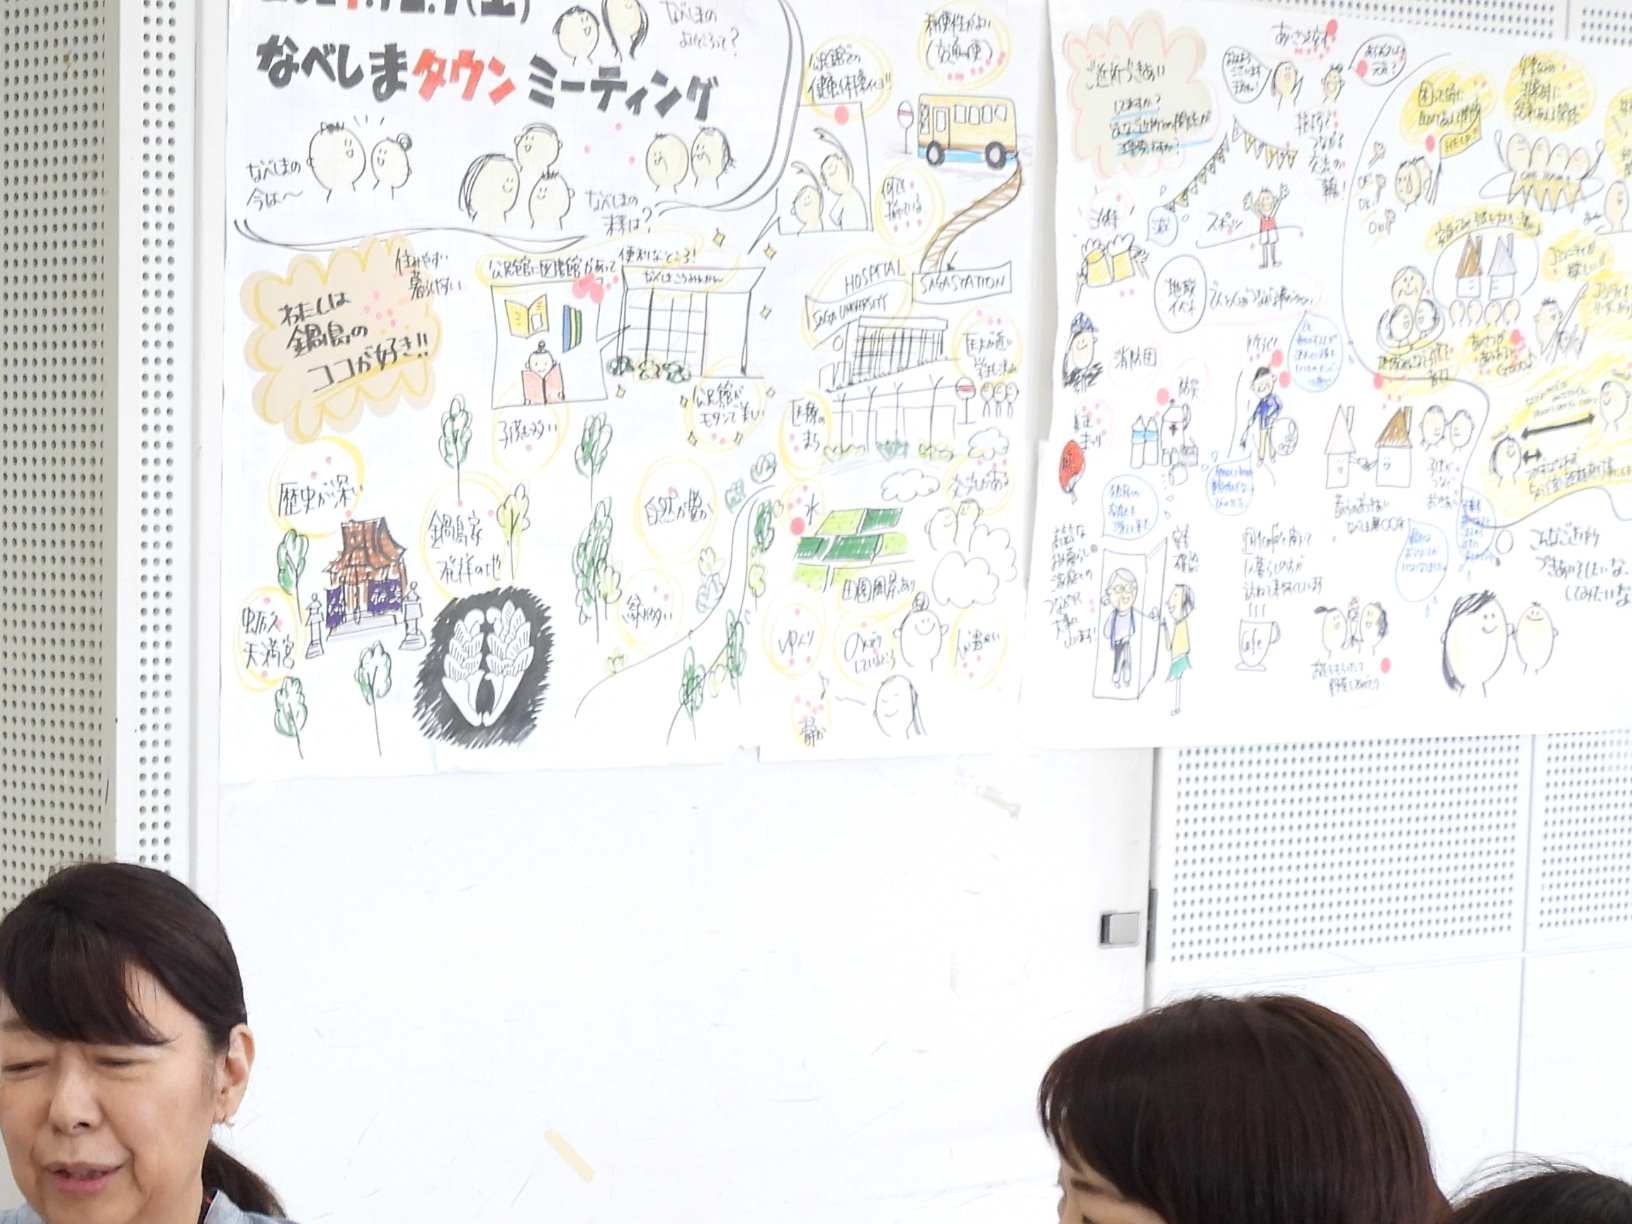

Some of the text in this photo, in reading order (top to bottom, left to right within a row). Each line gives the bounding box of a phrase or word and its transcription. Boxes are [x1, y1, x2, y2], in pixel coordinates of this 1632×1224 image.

[246, 160, 302, 182] なべしまの
[584, 189, 639, 212] なべしまの
[278, 290, 353, 326] わたしは
[285, 321, 369, 359] 鍋島の
[278, 473, 364, 517] 歴史が深い
[428, 508, 484, 549] 鍋島家
